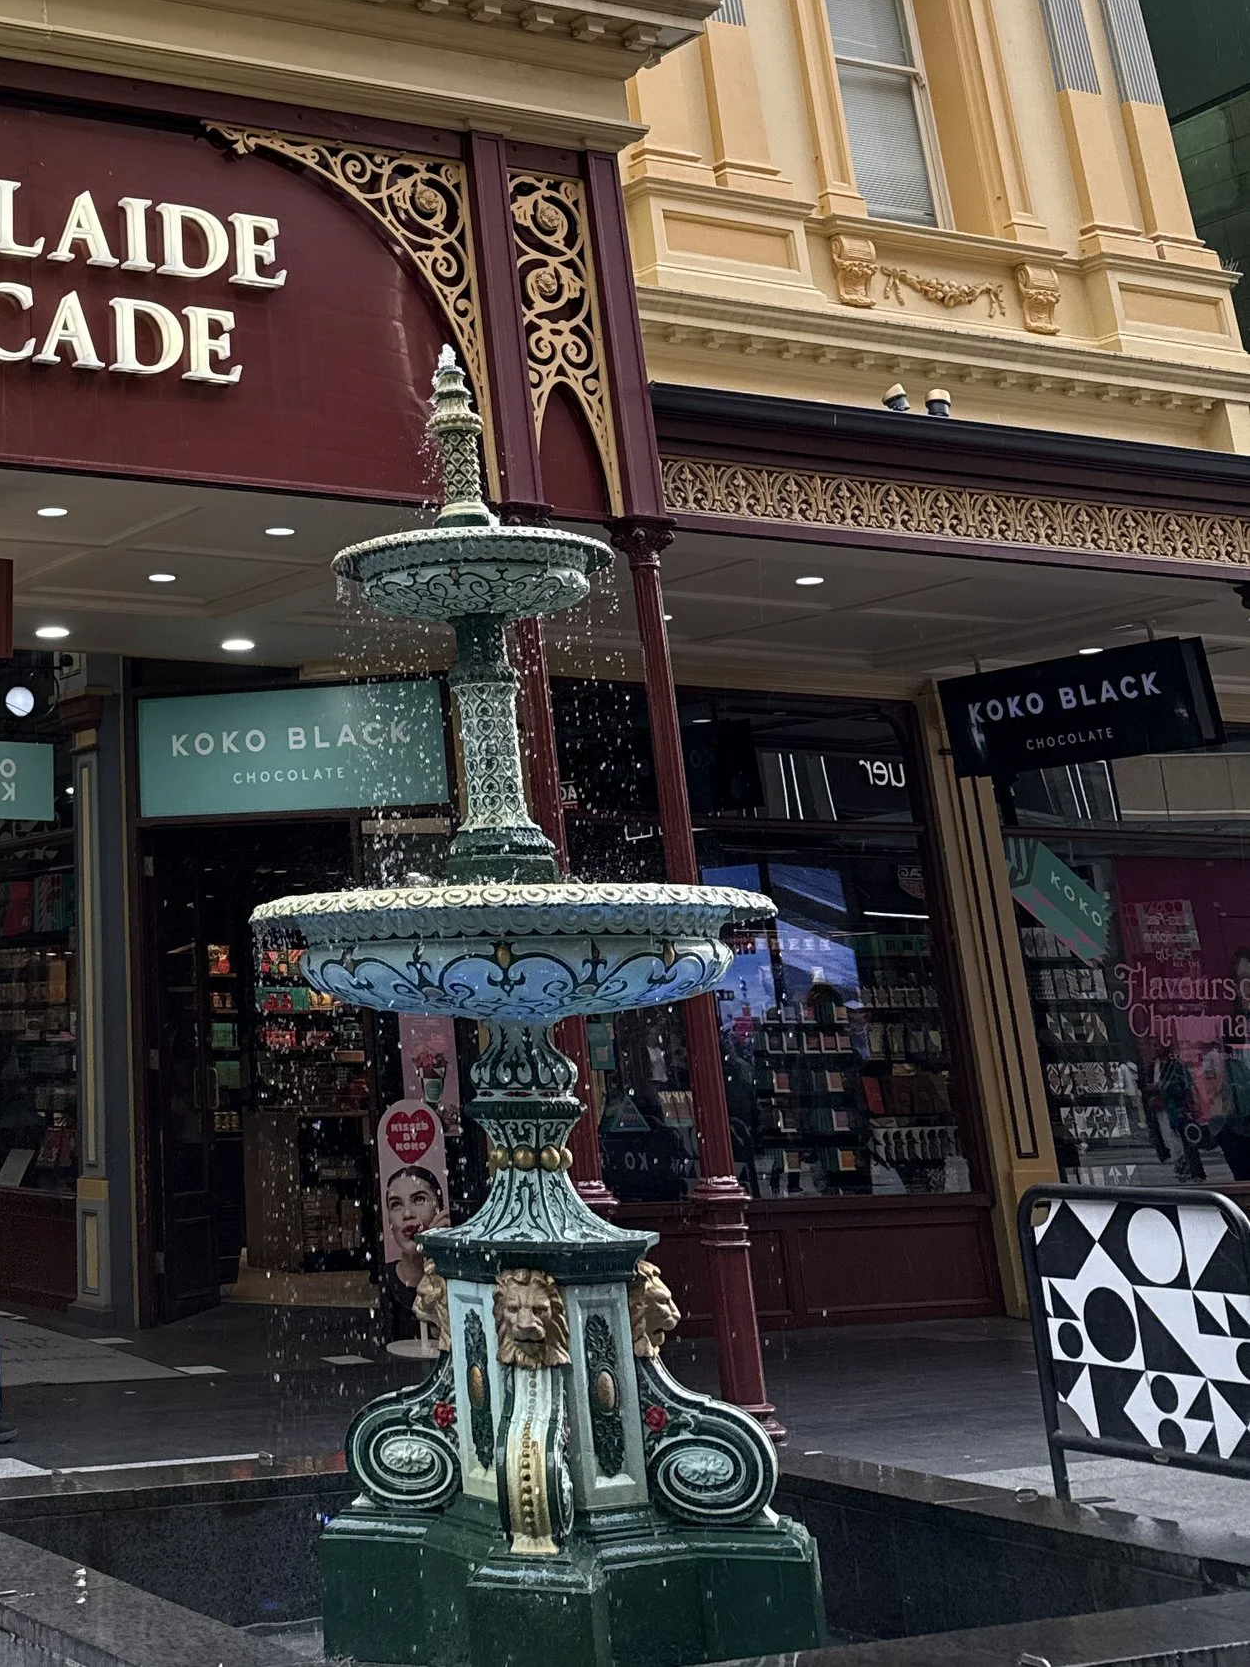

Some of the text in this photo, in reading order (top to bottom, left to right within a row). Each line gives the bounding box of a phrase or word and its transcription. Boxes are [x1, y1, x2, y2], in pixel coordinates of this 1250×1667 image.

[968, 671, 1162, 723] KOKO BLACK
[171, 720, 410, 757] KOKO BLACK
[1026, 727, 1114, 750] CHOCOLATE
[233, 766, 345, 784] CHOCOLATE
[1050, 871, 1103, 927] KOKO
[1113, 961, 1237, 1010] Flavours
[390, 1122, 429, 1132] KISSED
[403, 1133, 418, 1141] BY
[395, 1142, 427, 1151] KOKO
